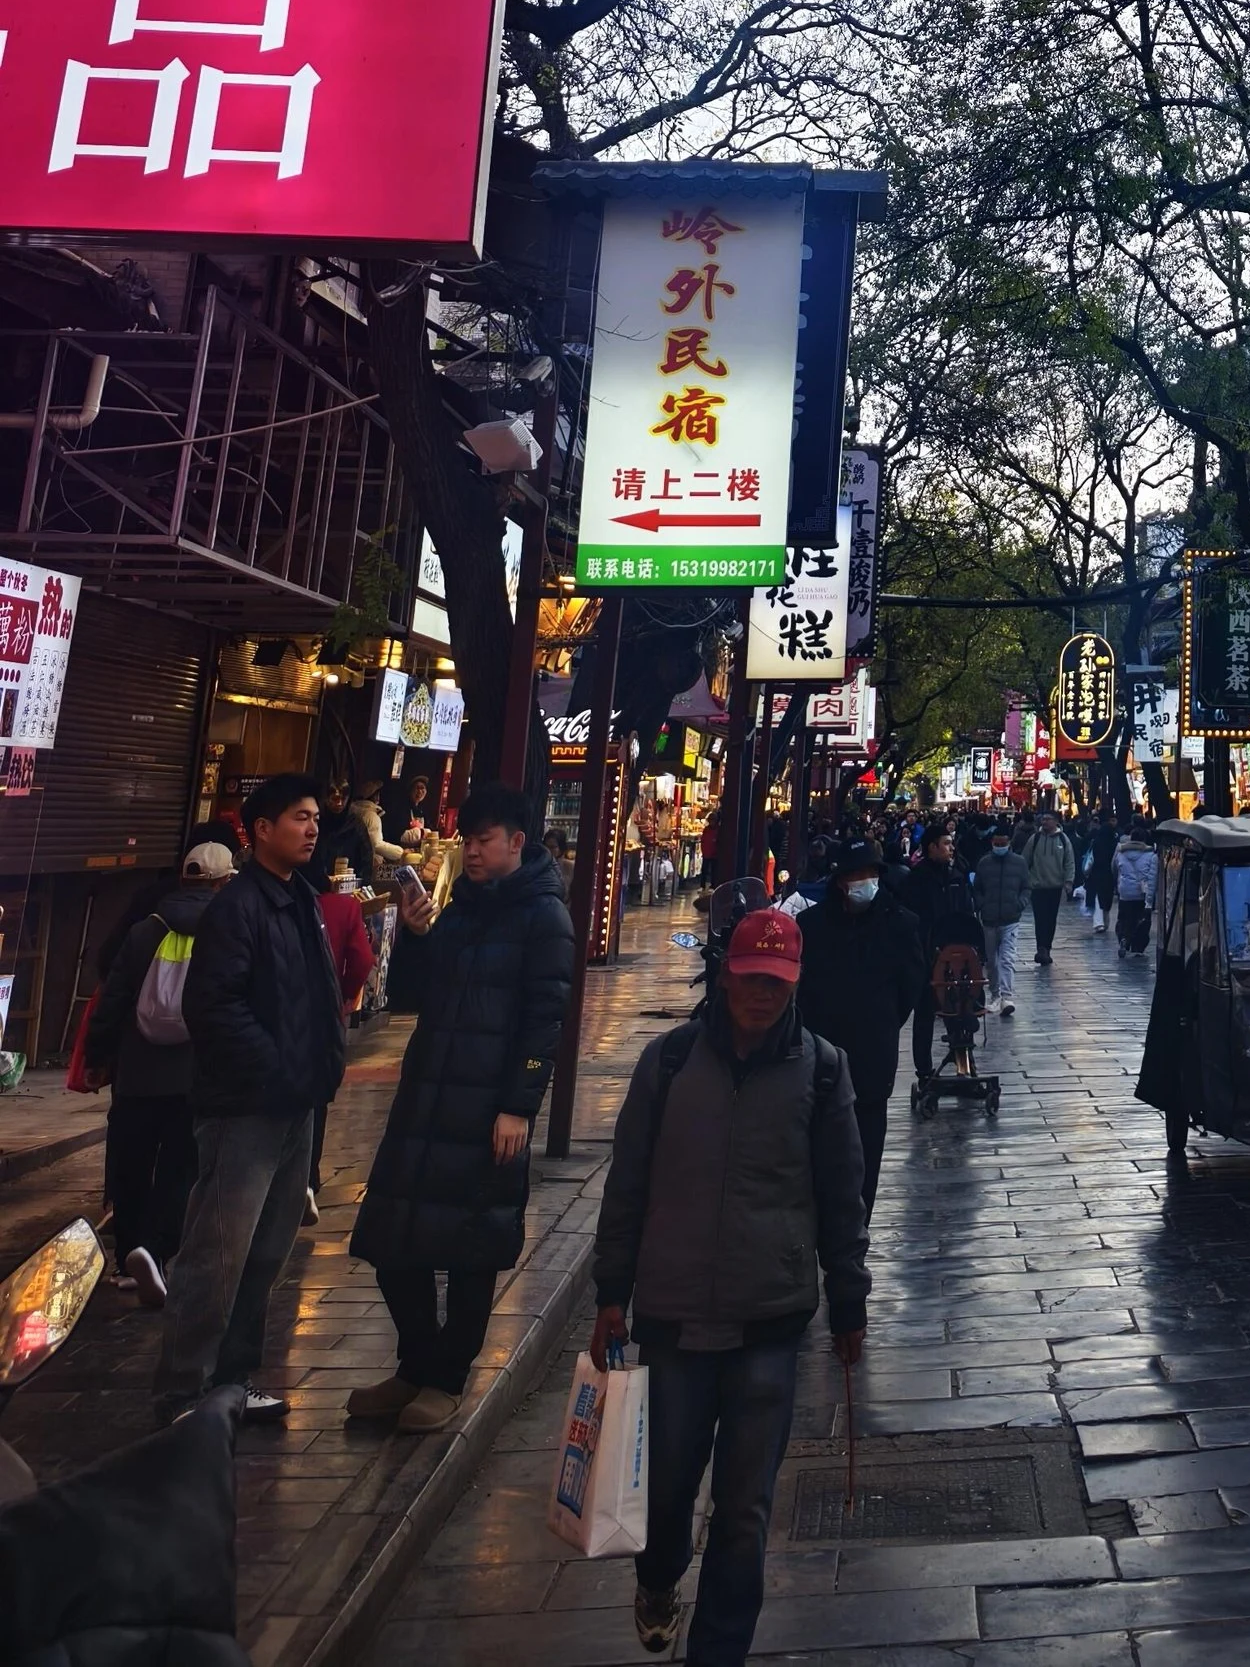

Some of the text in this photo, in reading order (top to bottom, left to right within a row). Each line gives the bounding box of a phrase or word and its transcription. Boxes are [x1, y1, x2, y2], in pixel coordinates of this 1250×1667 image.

[647, 206, 744, 447] 岭外民宿
[612, 466, 761, 503] 请上二楼
